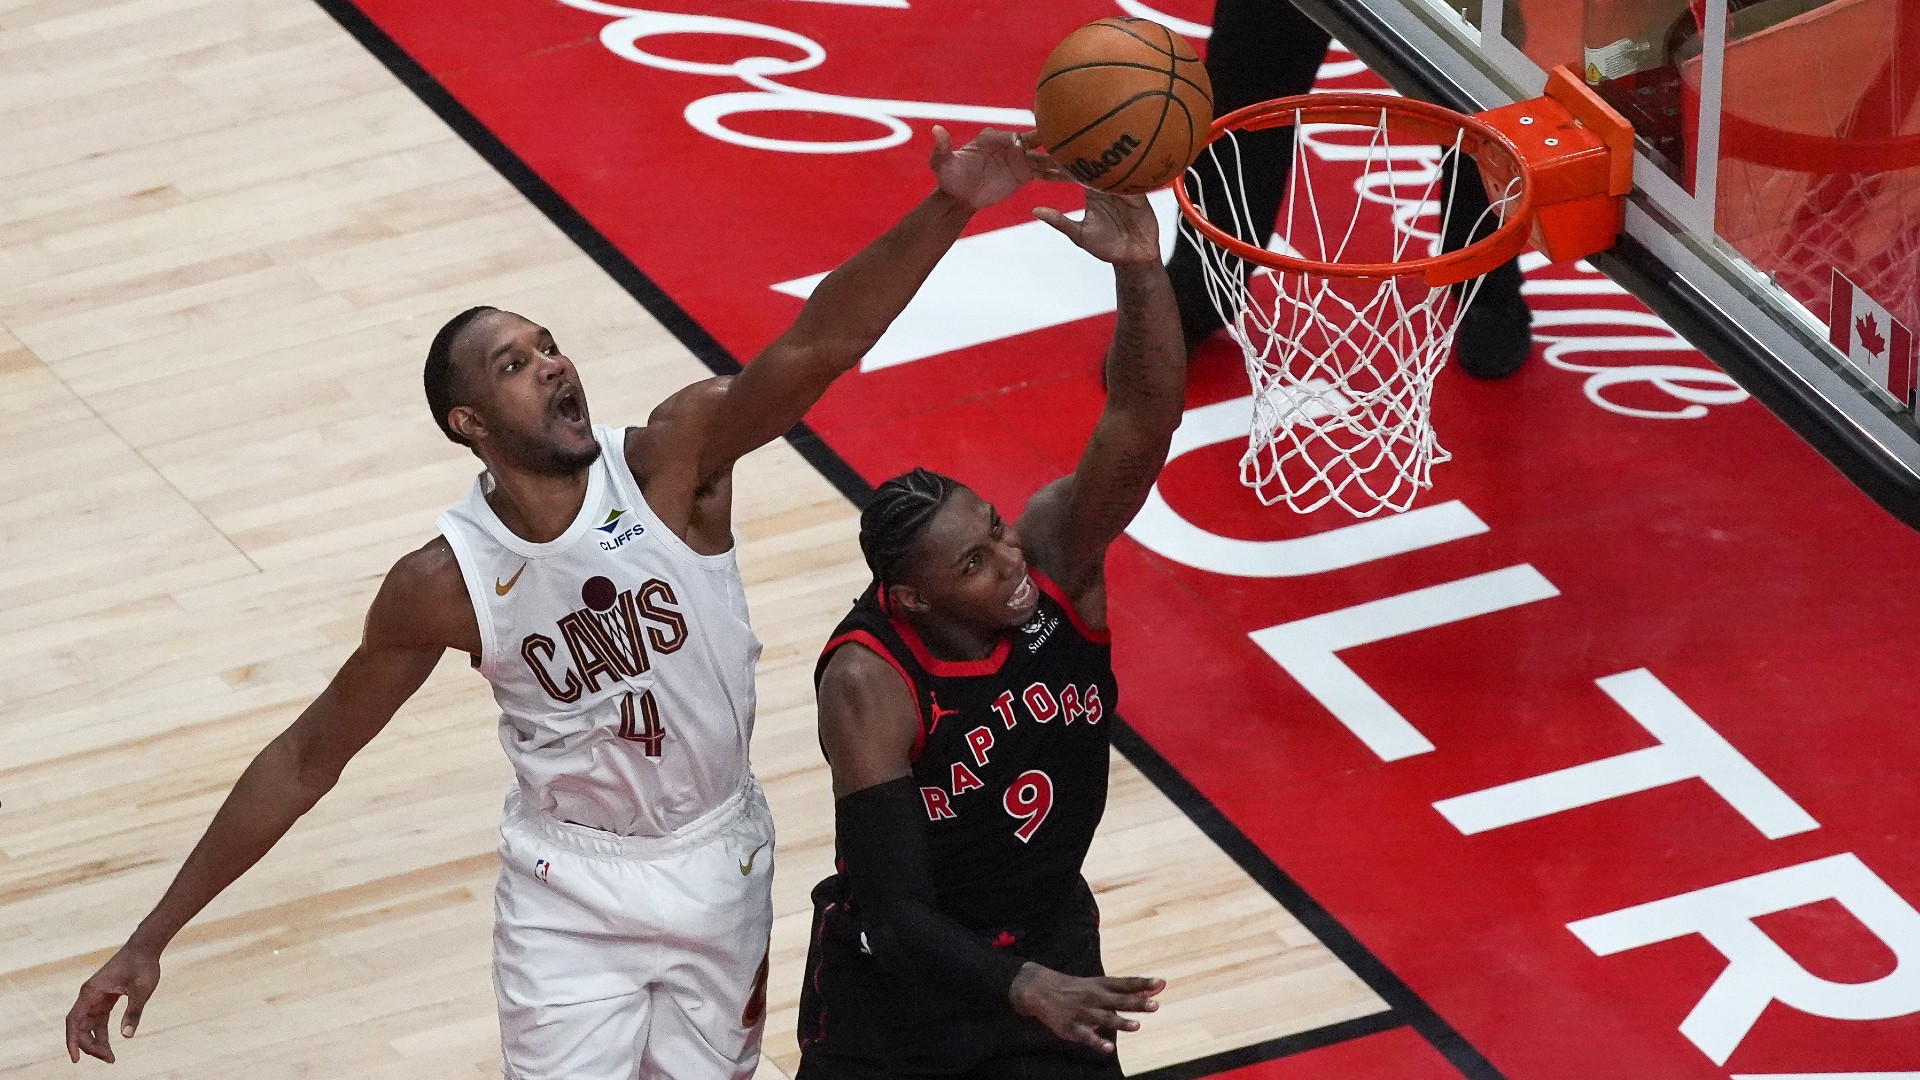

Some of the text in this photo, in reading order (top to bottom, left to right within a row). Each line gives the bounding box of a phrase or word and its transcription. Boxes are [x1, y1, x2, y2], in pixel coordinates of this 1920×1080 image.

[599, 524, 645, 551] CLIFFS
[520, 577, 689, 703] CAVS
[1028, 617, 1059, 654] Sun Life
[617, 688, 666, 757] 4
[919, 681, 1103, 822] RAPTORS
[1003, 769, 1054, 844] 9
